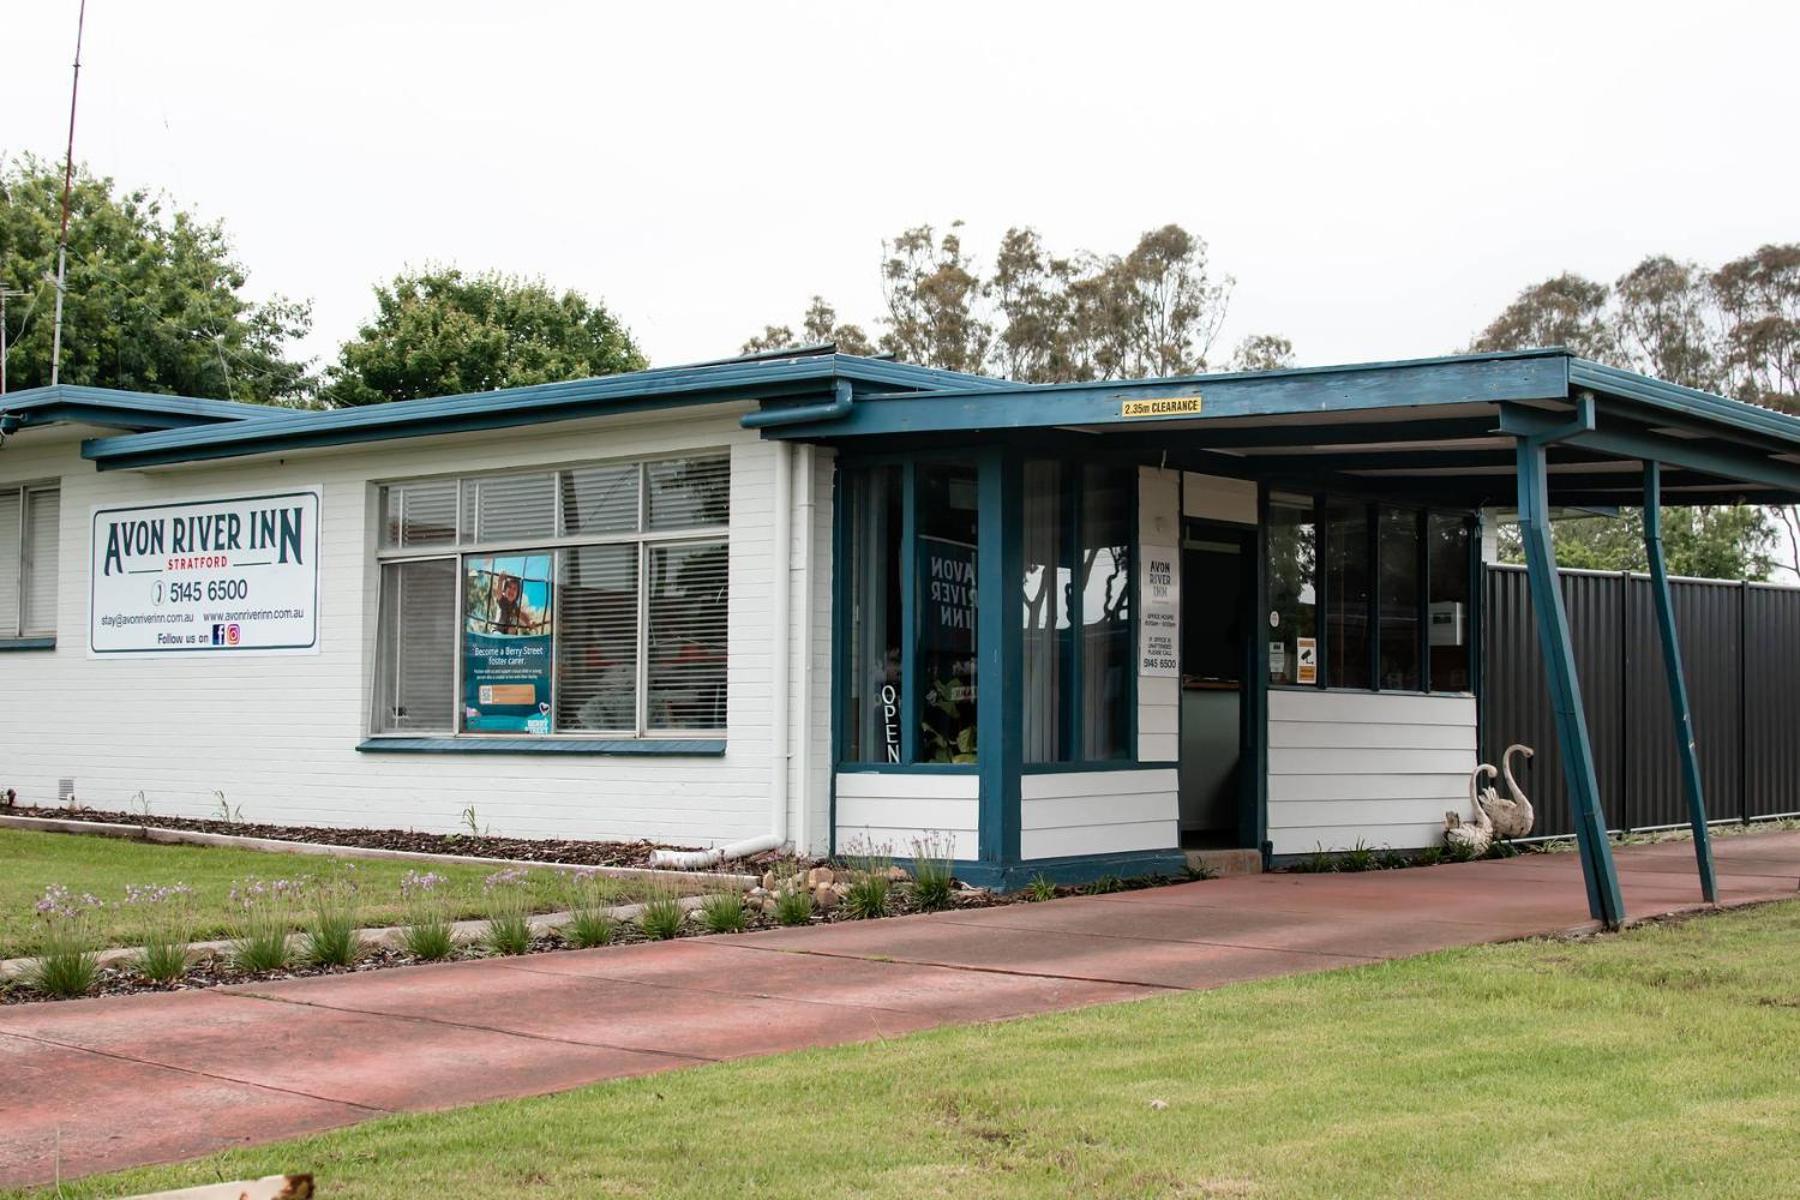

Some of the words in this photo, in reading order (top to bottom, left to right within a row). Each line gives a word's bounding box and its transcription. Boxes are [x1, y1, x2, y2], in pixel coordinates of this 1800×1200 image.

[1125, 404, 1150, 414] 2.35m
[1152, 400, 1198, 413] CLEARANCE
[104, 519, 164, 576] AVON
[172, 513, 241, 553] RIVER
[249, 507, 304, 565] INN
[168, 556, 228, 570] STRATFORD
[1150, 561, 1170, 573] AVON
[1149, 573, 1171, 585] RIVER
[170, 582, 201, 602] 5145
[208, 579, 247, 600] 6500
[101, 613, 194, 628] stay@avonriverinn.com.au
[203, 608, 304, 621] www.avonriverinn.com.au
[158, 633, 183, 644] Follow
[186, 635, 196, 643] us
[199, 635, 208, 643] on
[474, 647, 499, 656] Become
[505, 646, 522, 657] Berry
[523, 646, 544, 655] Street
[489, 657, 507, 666] foster
[1143, 658, 1158, 668] 5145
[1159, 659, 1177, 669] 6500
[881, 684, 900, 765] OPEN
